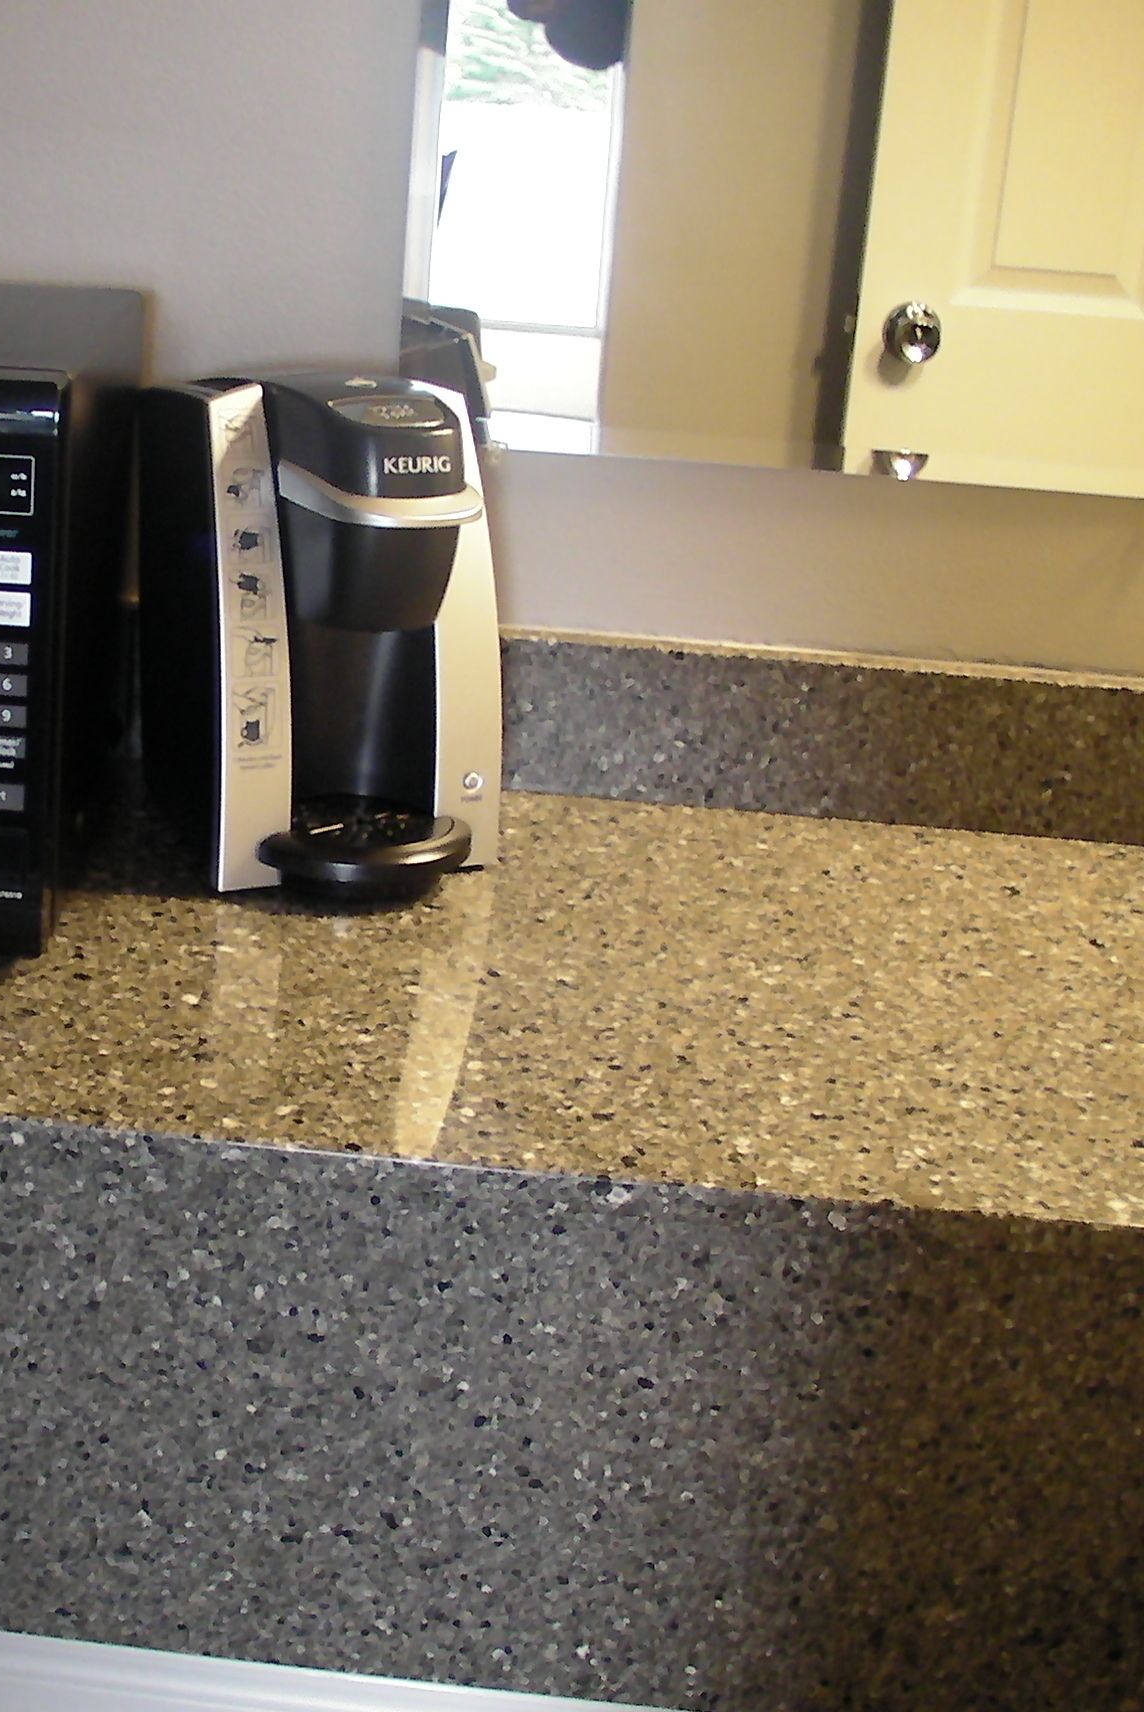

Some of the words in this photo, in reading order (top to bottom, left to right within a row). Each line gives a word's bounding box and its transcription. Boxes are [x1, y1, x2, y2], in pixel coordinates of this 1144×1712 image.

[383, 456, 452, 474] KEURIG
[4, 646, 13, 659] 3
[2, 677, 12, 691] 6
[1, 709, 12, 722] 9
